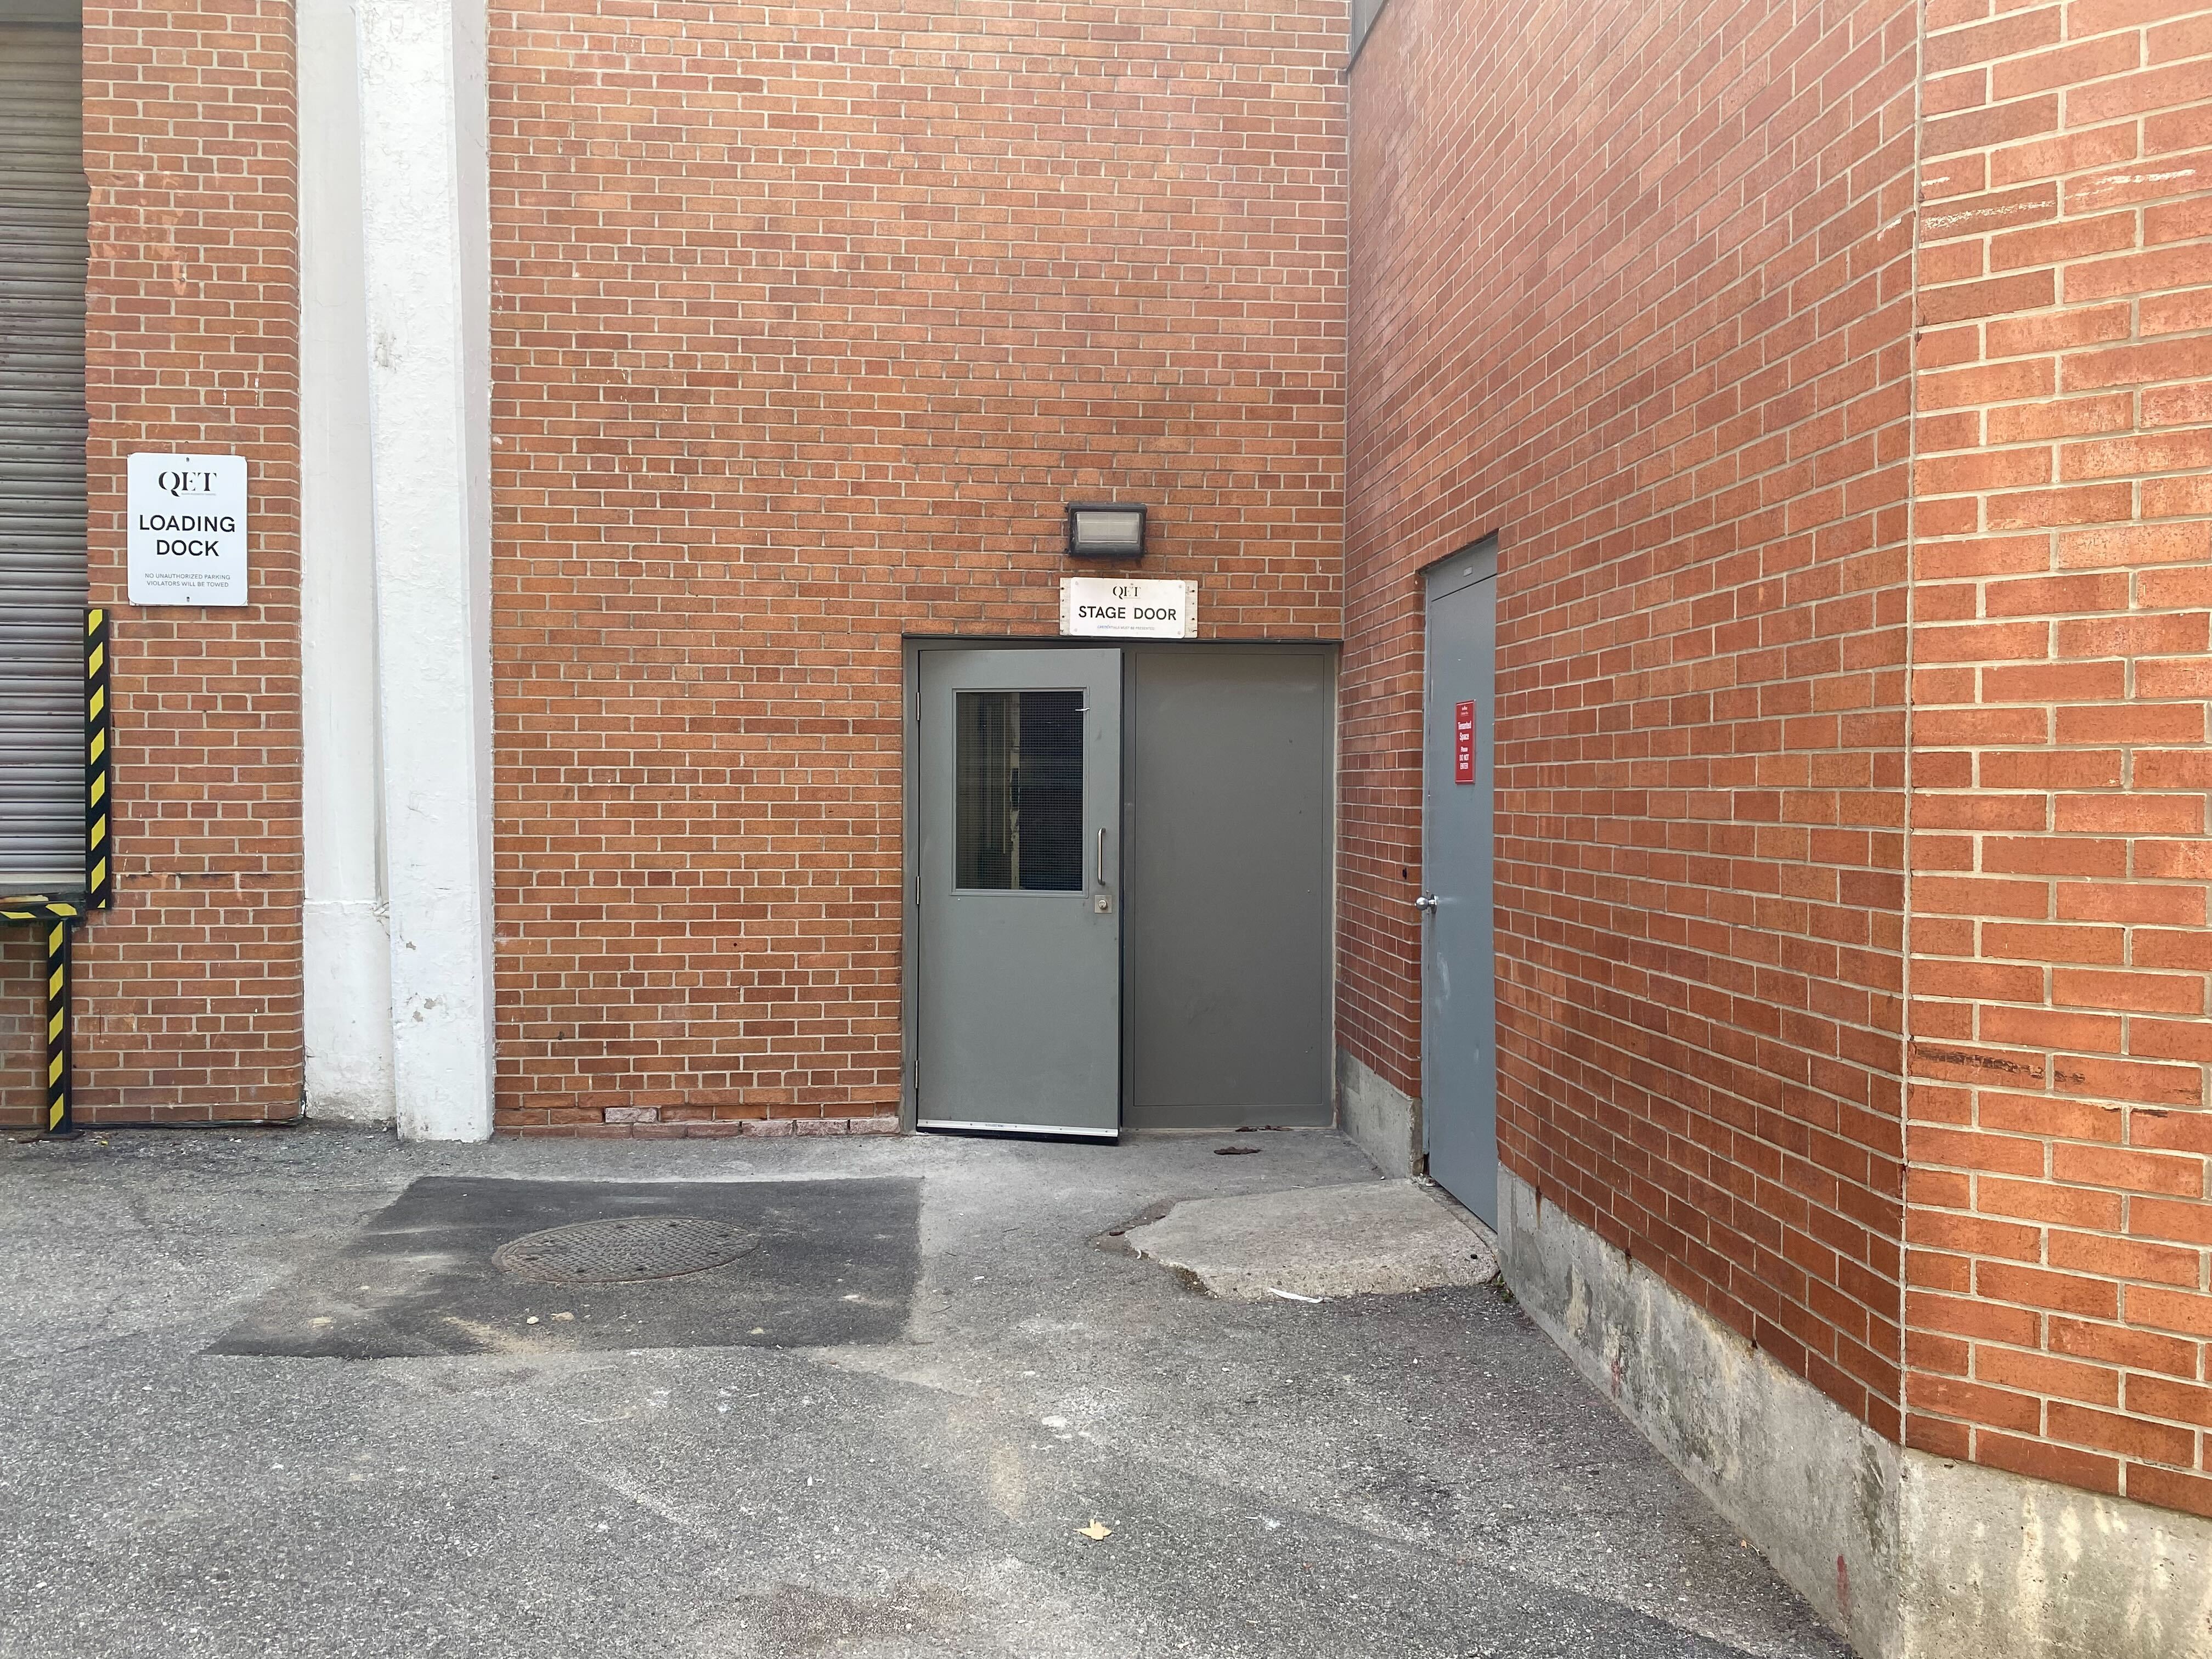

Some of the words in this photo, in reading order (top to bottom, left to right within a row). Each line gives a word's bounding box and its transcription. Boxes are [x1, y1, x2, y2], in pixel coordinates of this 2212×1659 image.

[158, 471, 217, 497] QET
[139, 515, 235, 532] LOADING
[156, 539, 219, 557] DOCK
[1113, 586, 1141, 600] QET
[1079, 606, 1126, 619] STAGE
[1134, 607, 1176, 620] DOOR
